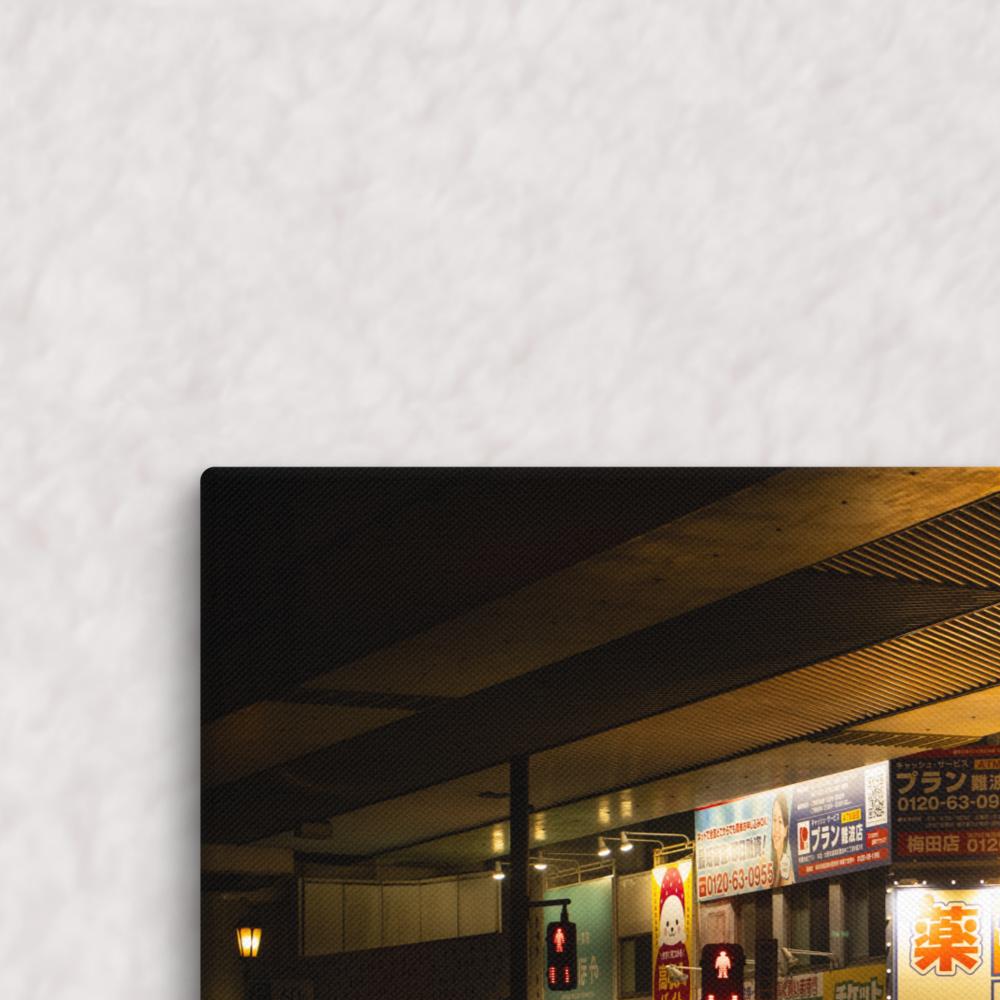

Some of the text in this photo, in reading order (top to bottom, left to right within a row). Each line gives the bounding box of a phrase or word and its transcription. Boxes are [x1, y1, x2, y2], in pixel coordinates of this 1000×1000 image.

[896, 771, 967, 794] プラン
[811, 824, 840, 852] プラン
[908, 835, 960, 853] 梅田店
[707, 863, 774, 896] 0120-63-0955
[913, 900, 983, 973] 薬
